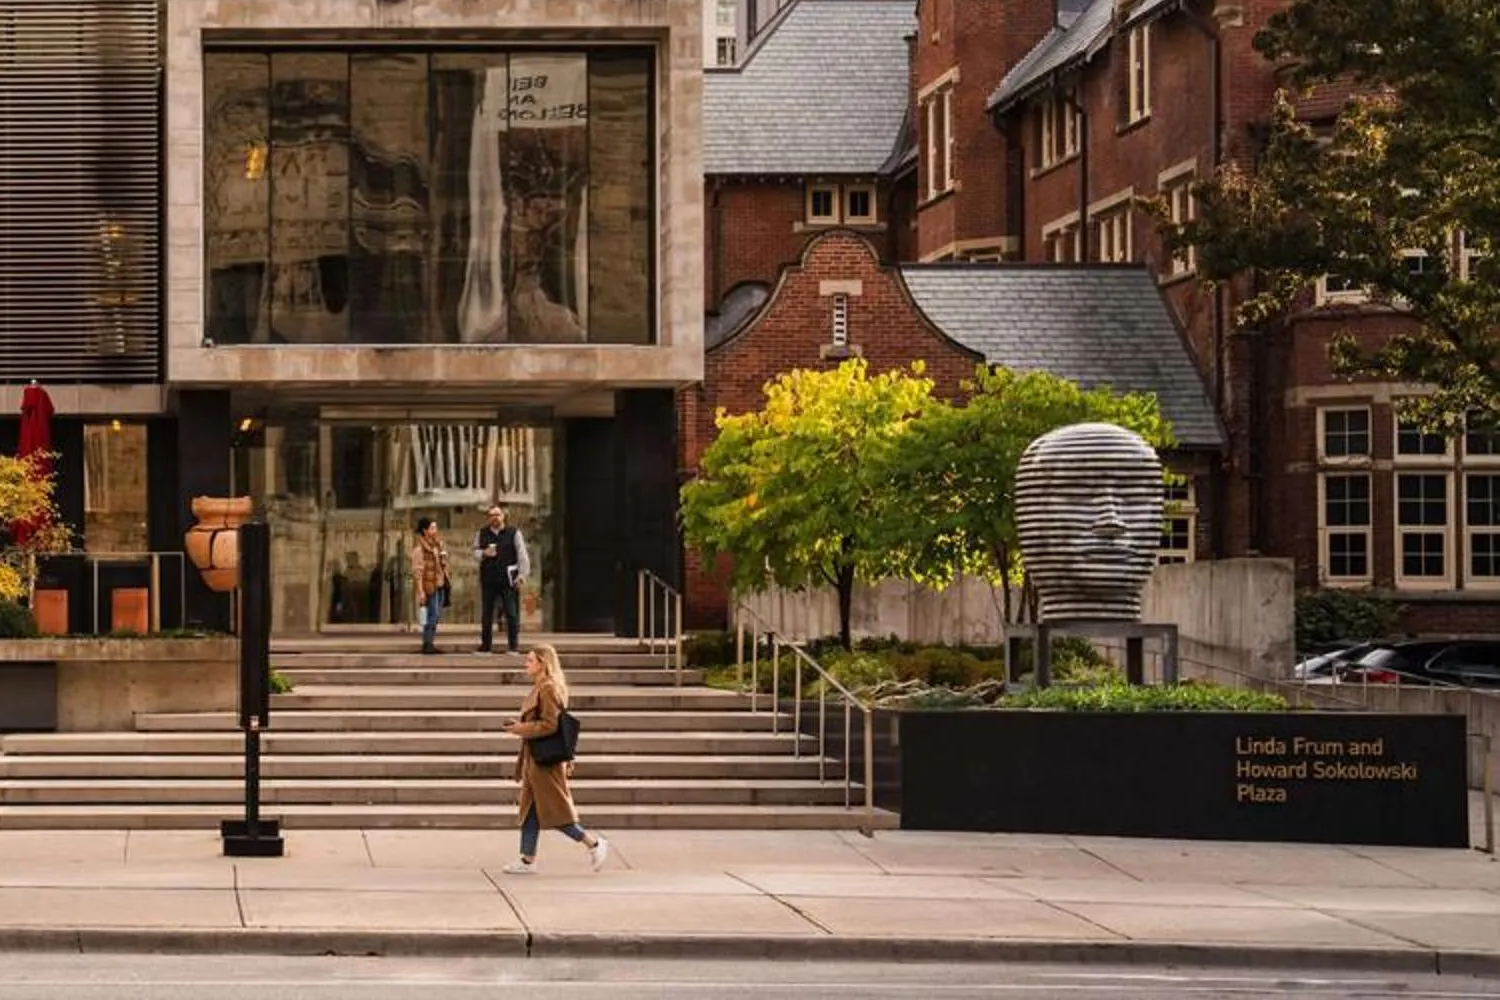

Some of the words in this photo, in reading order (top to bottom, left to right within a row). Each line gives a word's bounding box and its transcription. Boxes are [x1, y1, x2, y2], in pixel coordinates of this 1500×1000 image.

[1237, 737, 1286, 754] Linda
[1294, 737, 1343, 754] Frum
[1349, 738, 1382, 755] and
[1237, 760, 1306, 778] Howard
[1314, 761, 1417, 778] Sokolowski
[1238, 784, 1286, 801] Plaza
